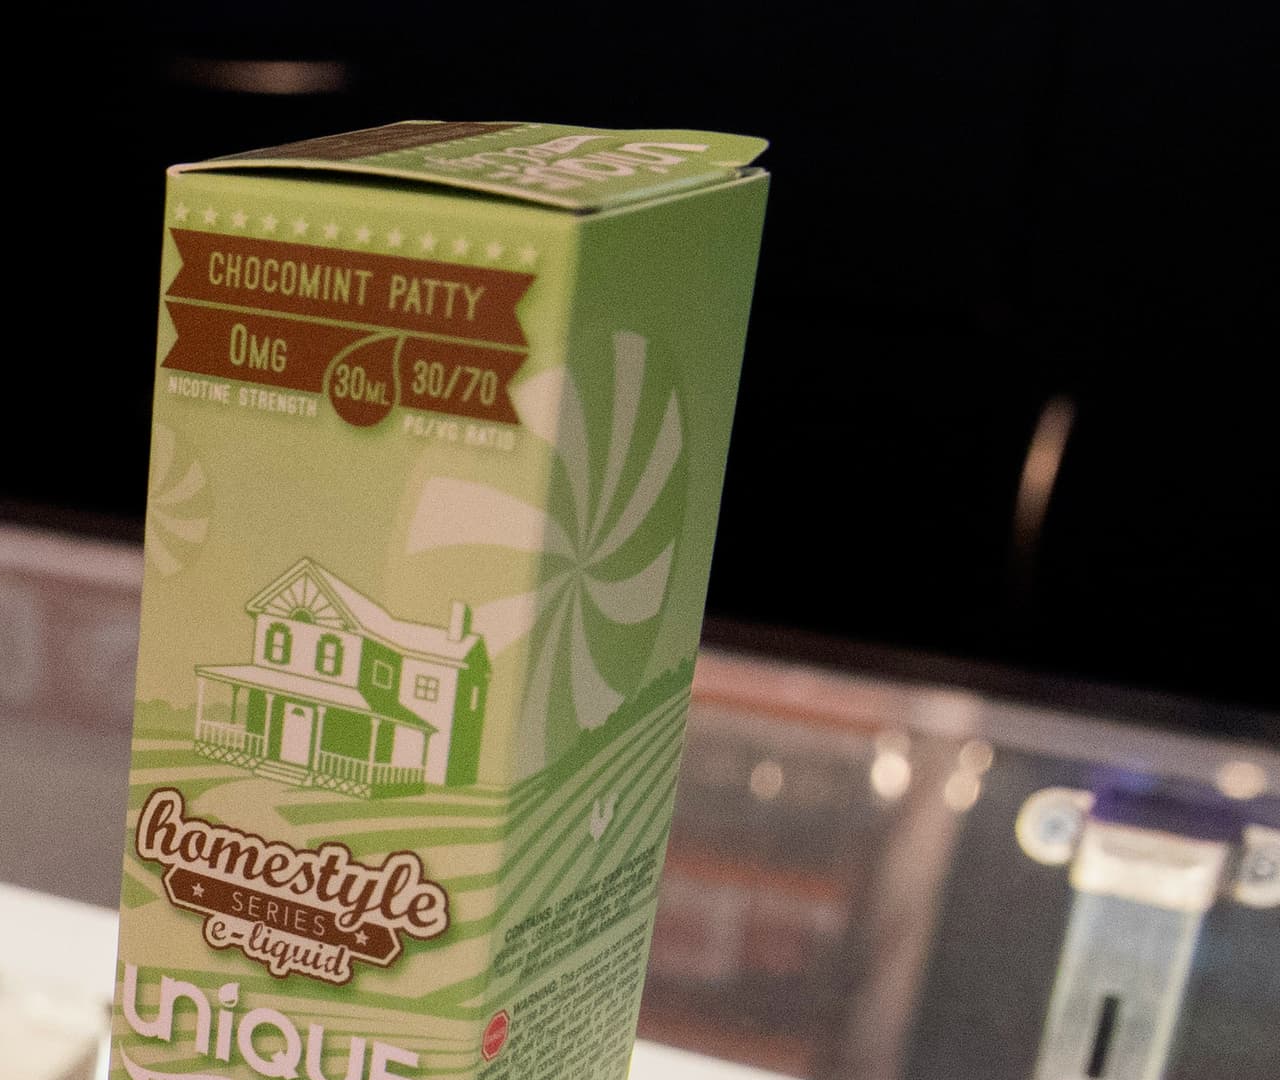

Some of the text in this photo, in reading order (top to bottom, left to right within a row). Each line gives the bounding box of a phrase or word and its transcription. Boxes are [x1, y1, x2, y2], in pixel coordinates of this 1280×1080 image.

[208, 251, 486, 322] CHOCOMINT PATTY
[168, 376, 318, 418] NICOTINE STRENGTH
[412, 359, 498, 406] 30/70
[145, 799, 438, 929] homestyle
[231, 892, 326, 937] SERIES
[210, 919, 346, 976] e-liquid
